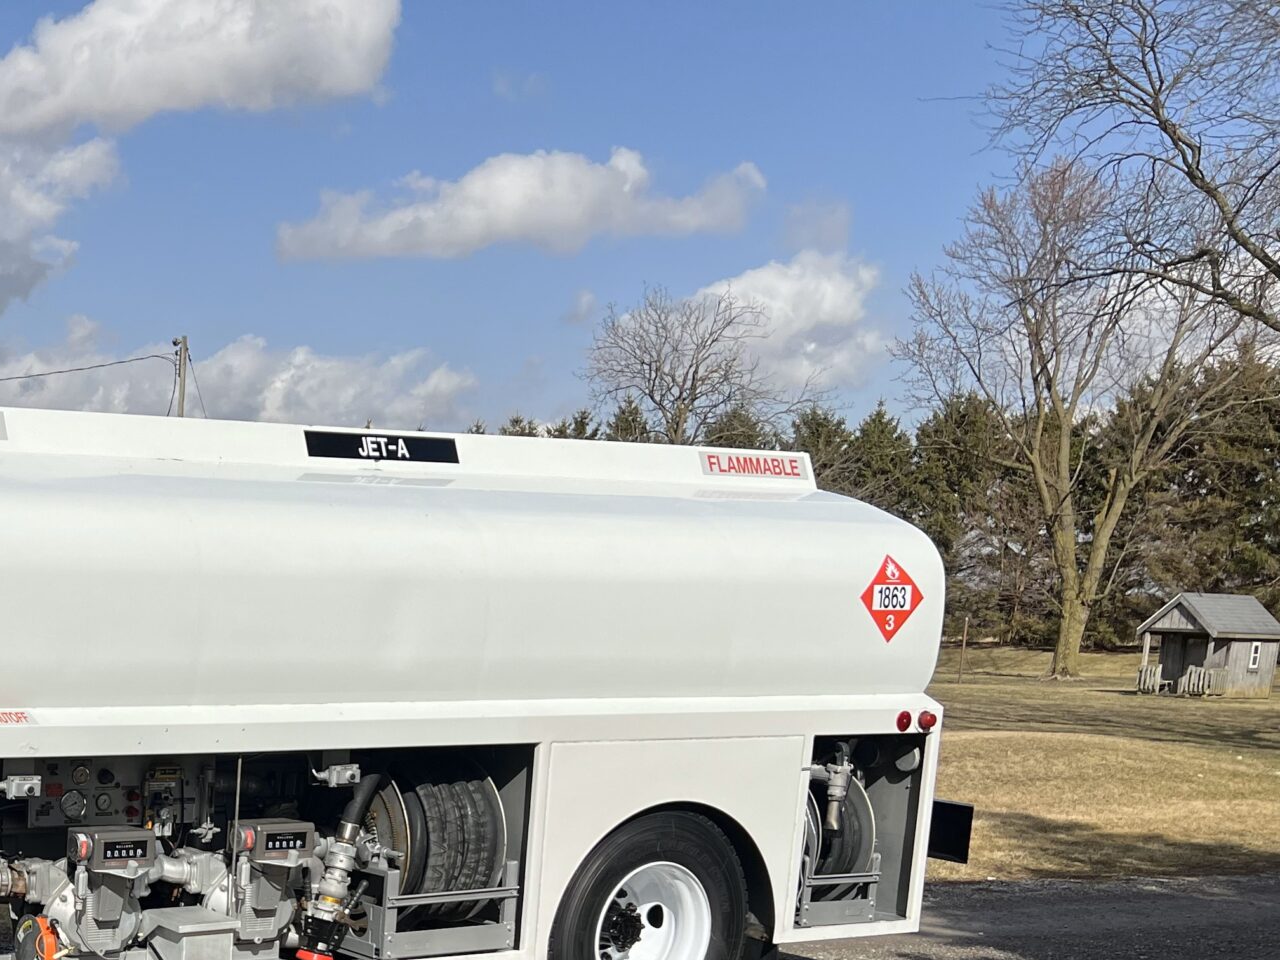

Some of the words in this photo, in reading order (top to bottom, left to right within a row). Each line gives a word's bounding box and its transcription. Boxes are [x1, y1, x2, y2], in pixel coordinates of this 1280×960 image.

[358, 436, 410, 458] JET-A
[707, 454, 801, 477] FLAMMABLE
[878, 586, 907, 609] 1863
[884, 614, 895, 631] 3
